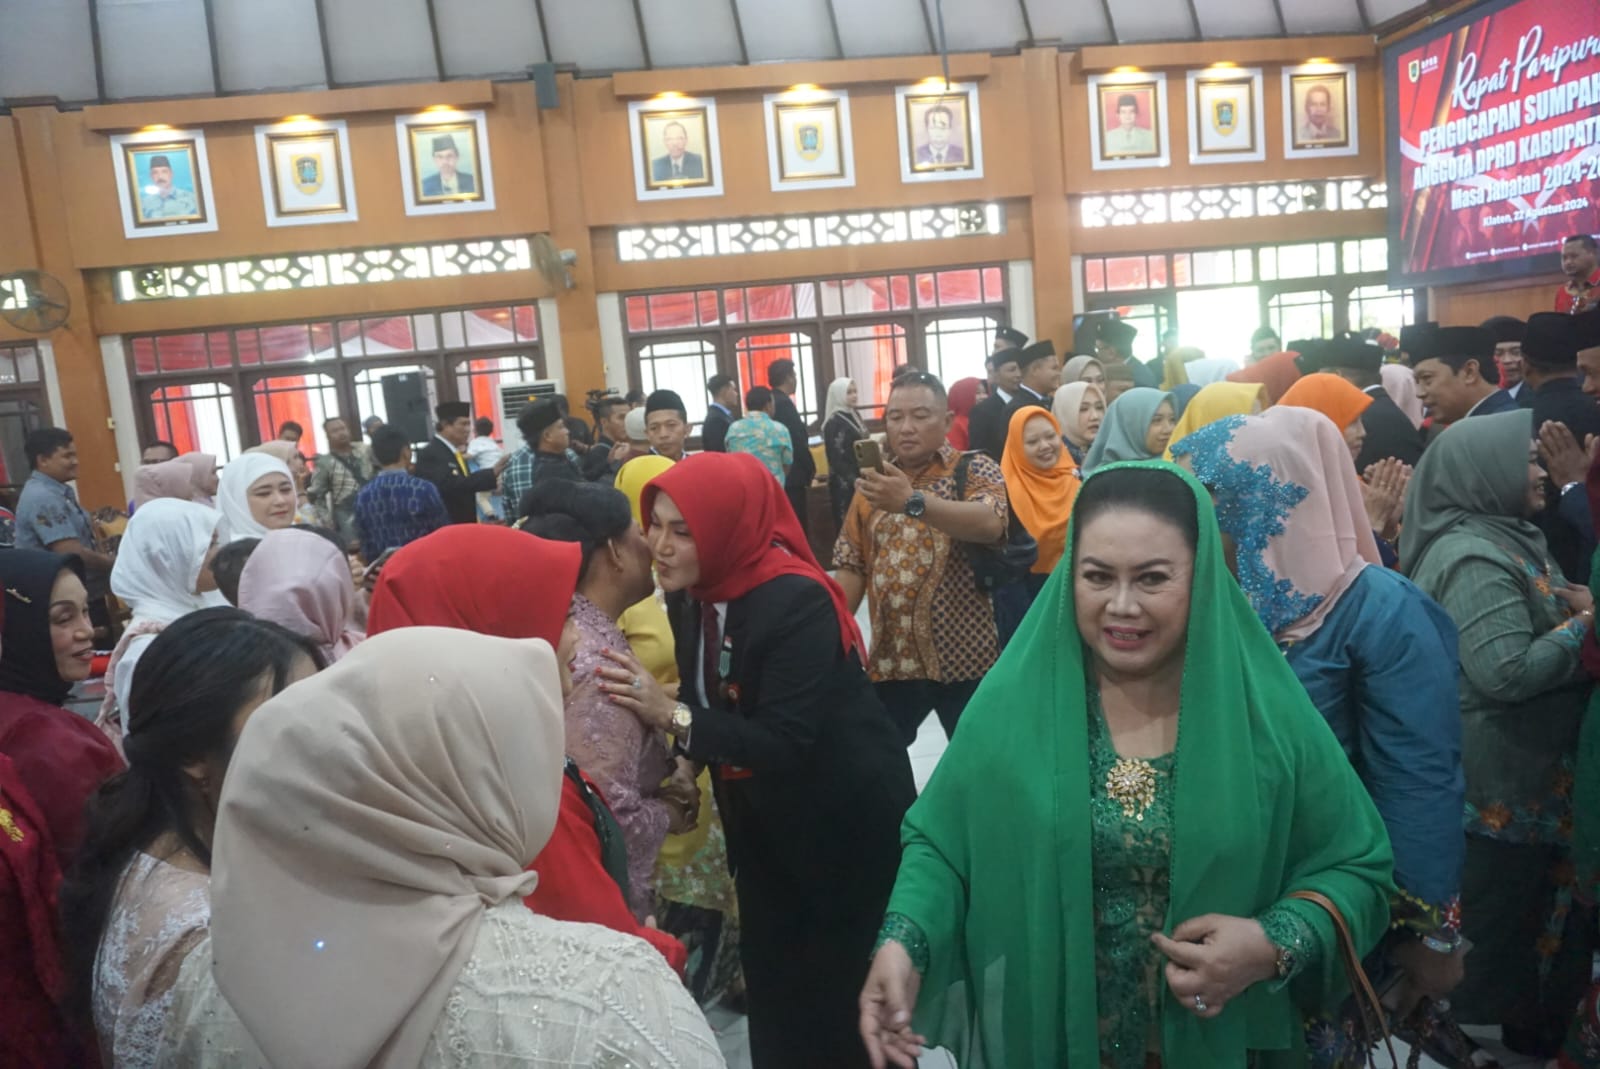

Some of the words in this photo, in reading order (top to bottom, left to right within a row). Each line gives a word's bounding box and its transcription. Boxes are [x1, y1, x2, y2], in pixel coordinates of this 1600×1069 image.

[1452, 52, 1511, 110] Rapat
[1420, 100, 1521, 157] PENGUCAPAN
[1414, 152, 1475, 190] ANGGOTA
[1476, 140, 1516, 173] DPRD
[1451, 187, 1486, 210] Masa
[1487, 173, 1541, 202] Jabatan
[1483, 211, 1513, 227] Klaten,
[1526, 203, 1564, 221] Agustus
[1564, 197, 1589, 211] 2024
